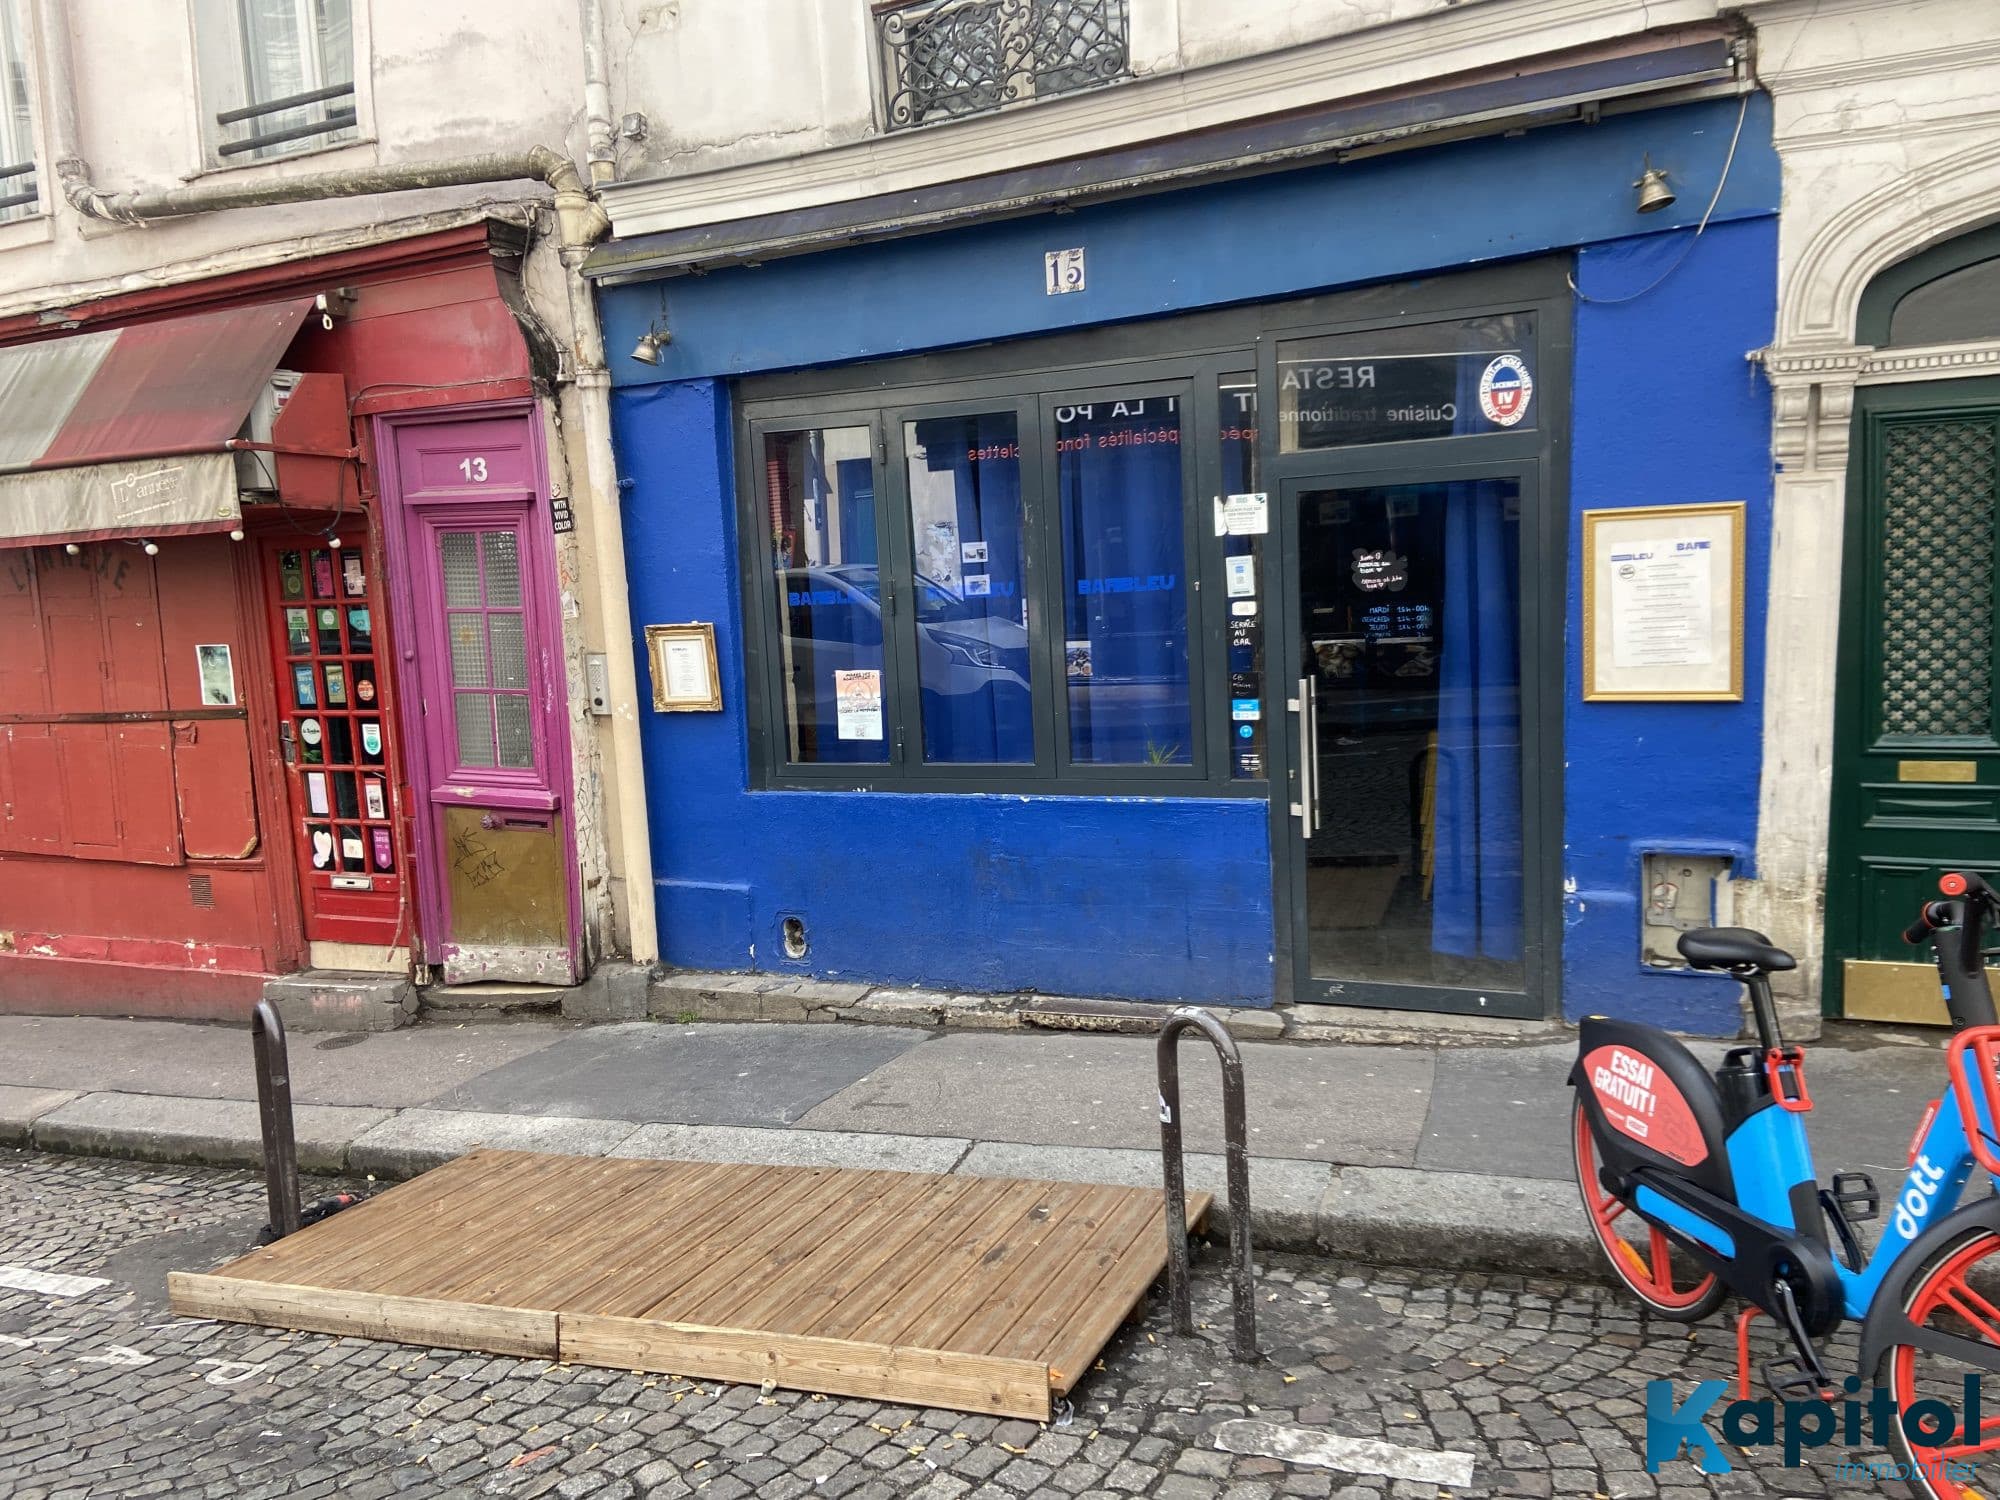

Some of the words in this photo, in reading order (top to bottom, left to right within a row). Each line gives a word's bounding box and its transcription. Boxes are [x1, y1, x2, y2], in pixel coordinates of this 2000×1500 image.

[1050, 256, 1082, 288] 15
[1498, 391, 1515, 405] IV
[459, 457, 488, 482] 13
[553, 500, 567, 510] WITH
[554, 510, 569, 520] VIVID
[554, 520, 571, 531] COLOR
[1234, 629, 1245, 637] AU
[1234, 638, 1251, 646] BAR
[1610, 1049, 1655, 1090] ESSAI
[1895, 1154, 1946, 1240] dott
